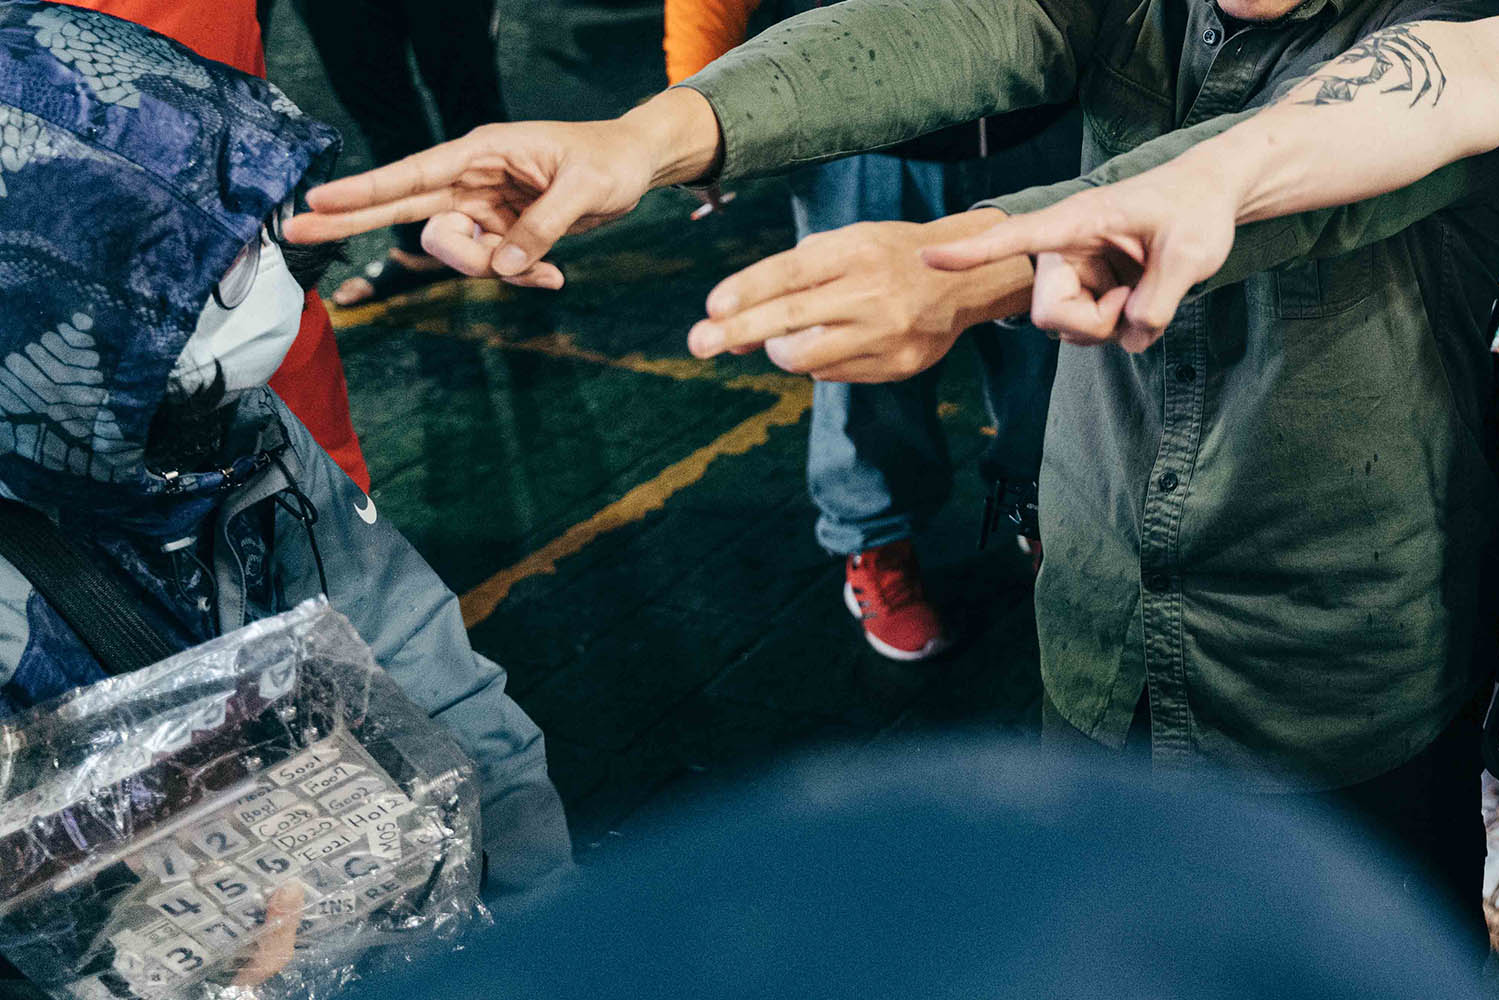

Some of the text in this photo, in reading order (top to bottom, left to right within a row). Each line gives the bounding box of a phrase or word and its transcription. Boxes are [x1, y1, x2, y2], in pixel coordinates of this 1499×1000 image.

[347, 799, 405, 828] H012
[215, 878, 248, 899] 5
[161, 898, 202, 917] 4
